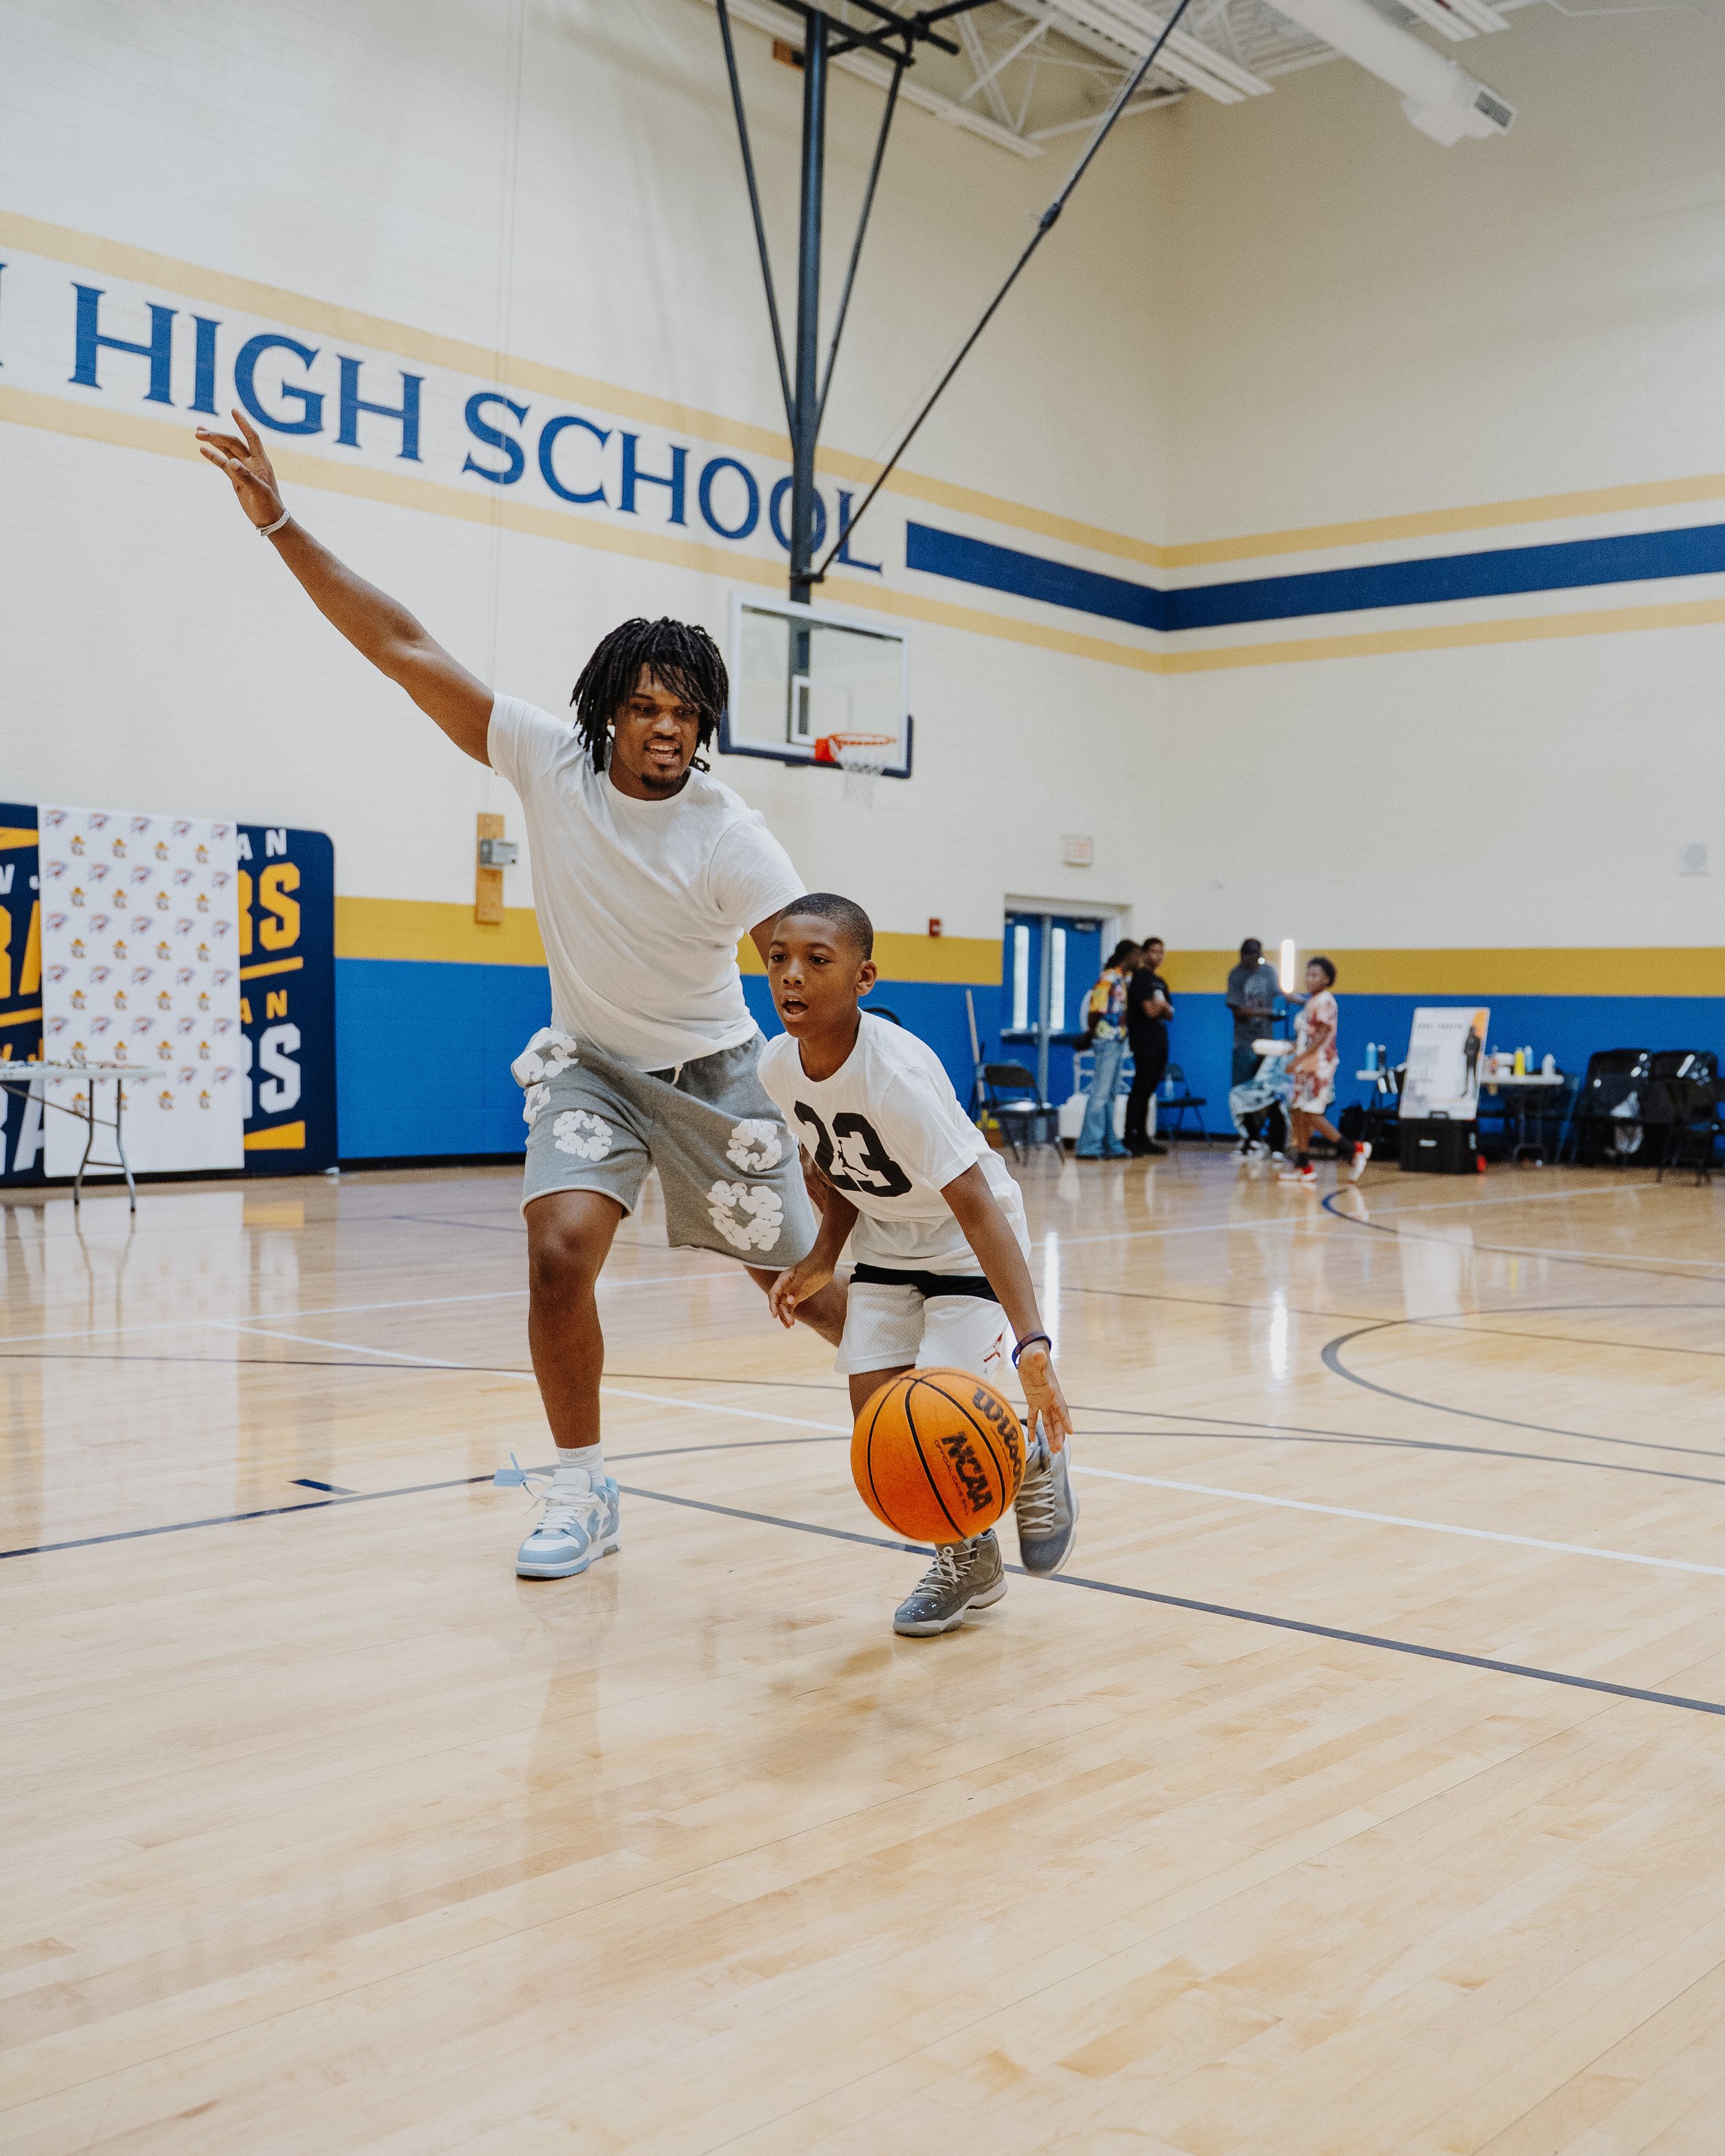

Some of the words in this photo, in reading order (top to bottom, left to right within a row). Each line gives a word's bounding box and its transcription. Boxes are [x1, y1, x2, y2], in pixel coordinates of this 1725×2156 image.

[68, 281, 425, 462] HIGH
[461, 391, 883, 575] SCHOOL
[793, 1100, 912, 1198] 23
[934, 1439, 952, 1476] OFFICIAL
[940, 1430, 994, 1513] NCAA
